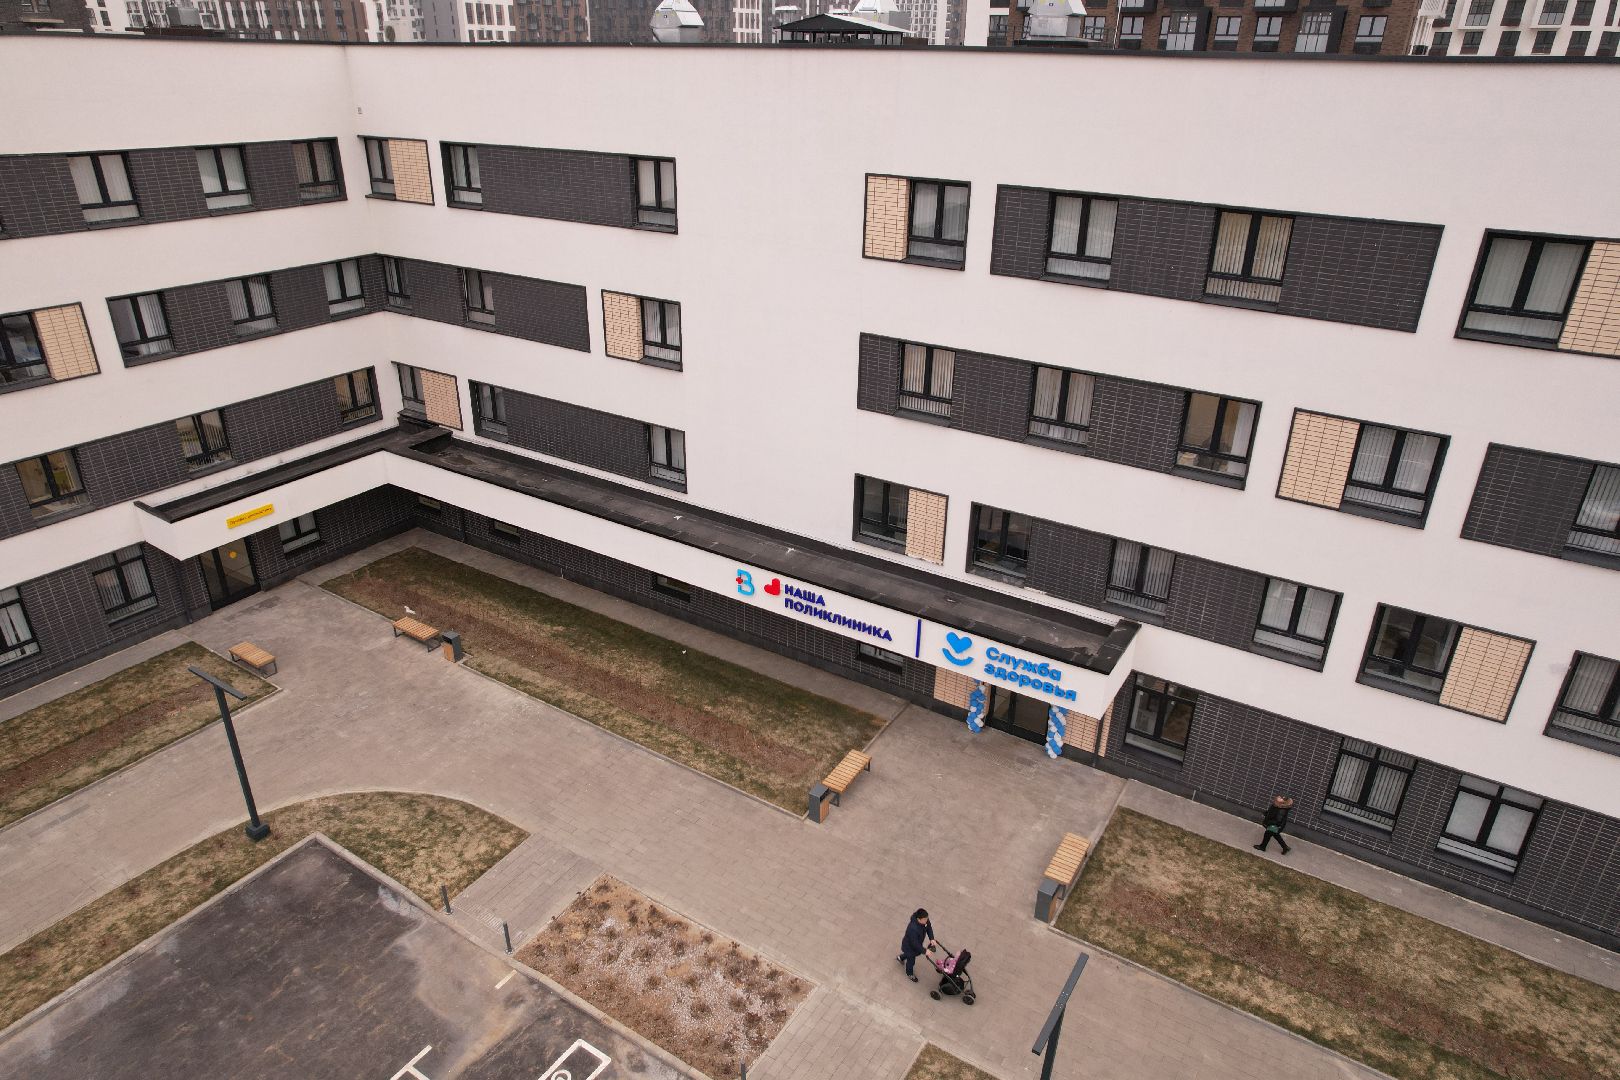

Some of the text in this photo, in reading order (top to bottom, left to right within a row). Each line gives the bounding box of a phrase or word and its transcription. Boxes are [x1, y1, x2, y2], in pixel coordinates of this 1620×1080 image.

[784, 583, 826, 606] НАША
[784, 597, 893, 642] ПОЛИКЛИНИКА
[983, 663, 1077, 702] здоровья
[985, 646, 1062, 682] Служба
